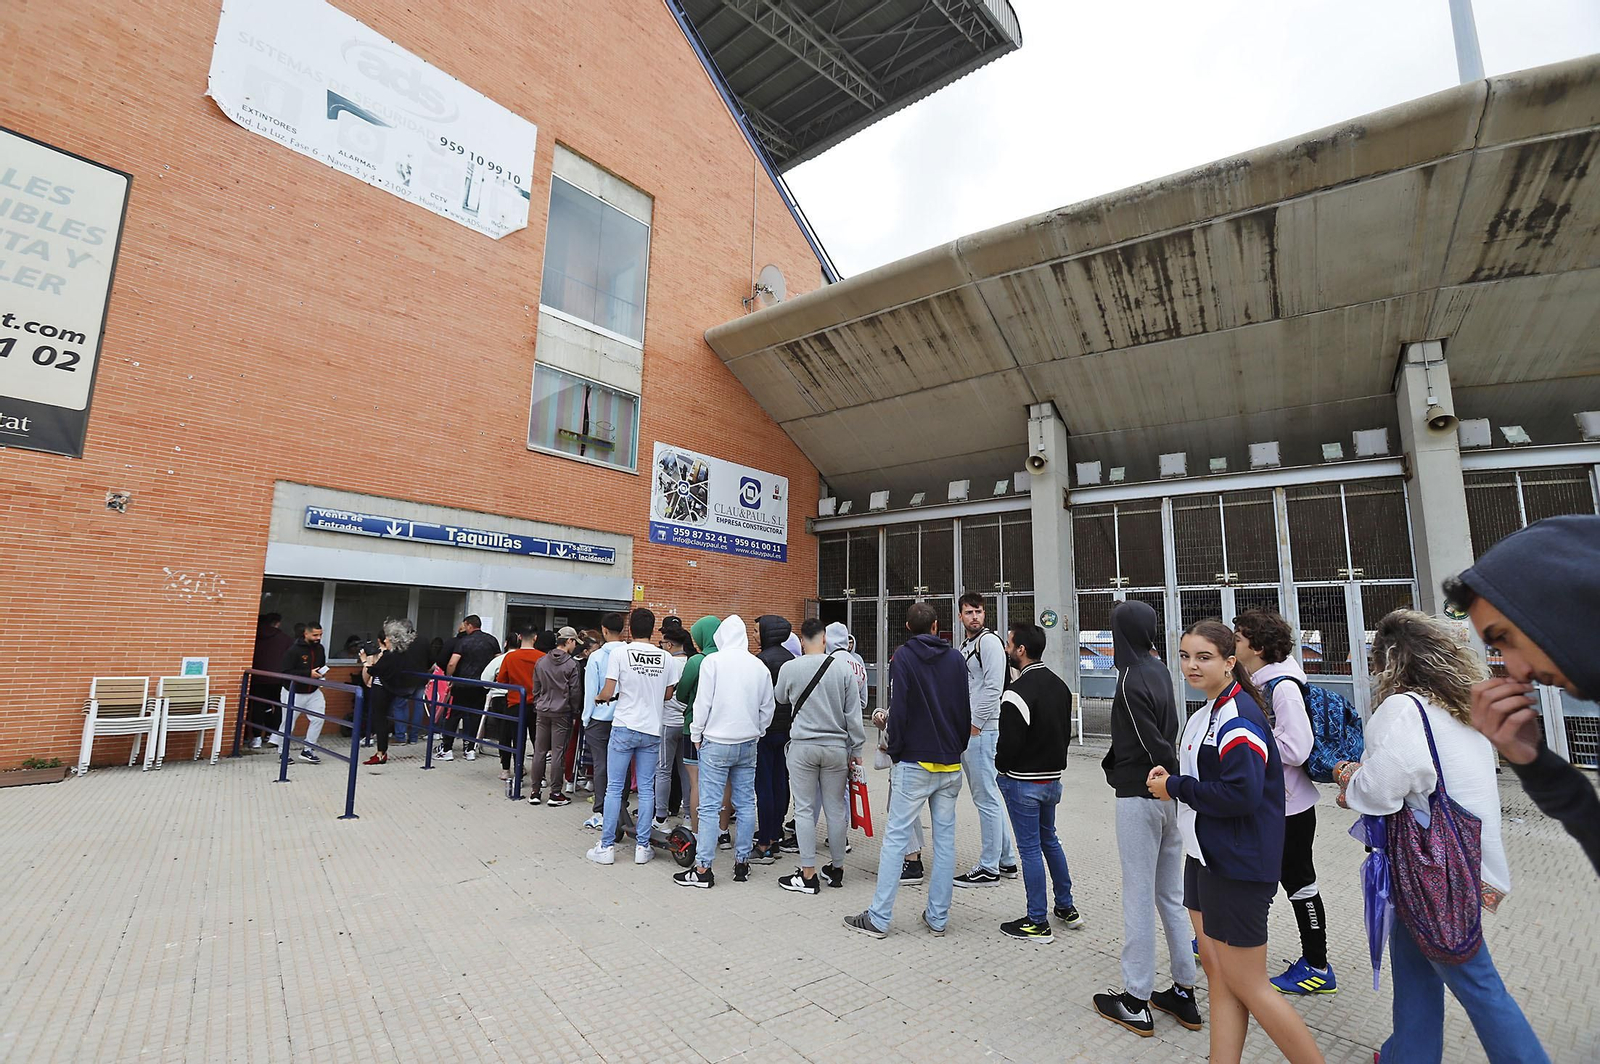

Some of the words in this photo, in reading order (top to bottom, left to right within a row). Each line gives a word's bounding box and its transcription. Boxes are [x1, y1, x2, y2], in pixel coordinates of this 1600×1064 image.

[238, 31, 323, 83] SISTEMAS
[328, 77, 351, 97] DE
[354, 91, 436, 141] SEGURIDAD
[357, 50, 446, 116] ads
[241, 104, 297, 134] EXTINTORES
[236, 112, 254, 127] Ind.
[256, 122, 267, 133] La
[290, 138, 310, 151] Fase
[312, 147, 319, 156] 6
[327, 154, 352, 171] Naves
[354, 166, 360, 175] 3
[363, 171, 368, 180] y
[384, 180, 412, 196] 21007
[419, 194, 443, 212] Huelva
[338, 149, 377, 171] ALARMAS
[440, 136, 465, 155] 959
[470, 151, 485, 166] 10
[487, 161, 503, 175] 99
[507, 171, 521, 185] 10
[0, 167, 76, 206] LES
[430, 192, 448, 204] CCTV
[0, 226, 50, 262] TA
[66, 246, 93, 269] Y
[2, 313, 87, 345] t.com
[32, 345, 81, 372] 02
[318, 519, 363, 532] Entradas
[319, 510, 347, 521] Venta
[350, 514, 363, 523] de
[716, 516, 742, 528] EMPRESA
[742, 522, 783, 536] CONSTRUCTORA
[445, 527, 523, 550] Taquillas
[572, 544, 592, 552] Salida
[672, 536, 728, 551] info@clauypaul.es
[673, 527, 690, 538] 959
[692, 530, 703, 539] 87
[705, 532, 716, 542] 52
[717, 535, 728, 544] 41
[734, 537, 749, 547] 959
[750, 540, 760, 549] 61
[761, 542, 771, 551] 00
[772, 544, 781, 553] 11
[631, 652, 662, 665] VANS
